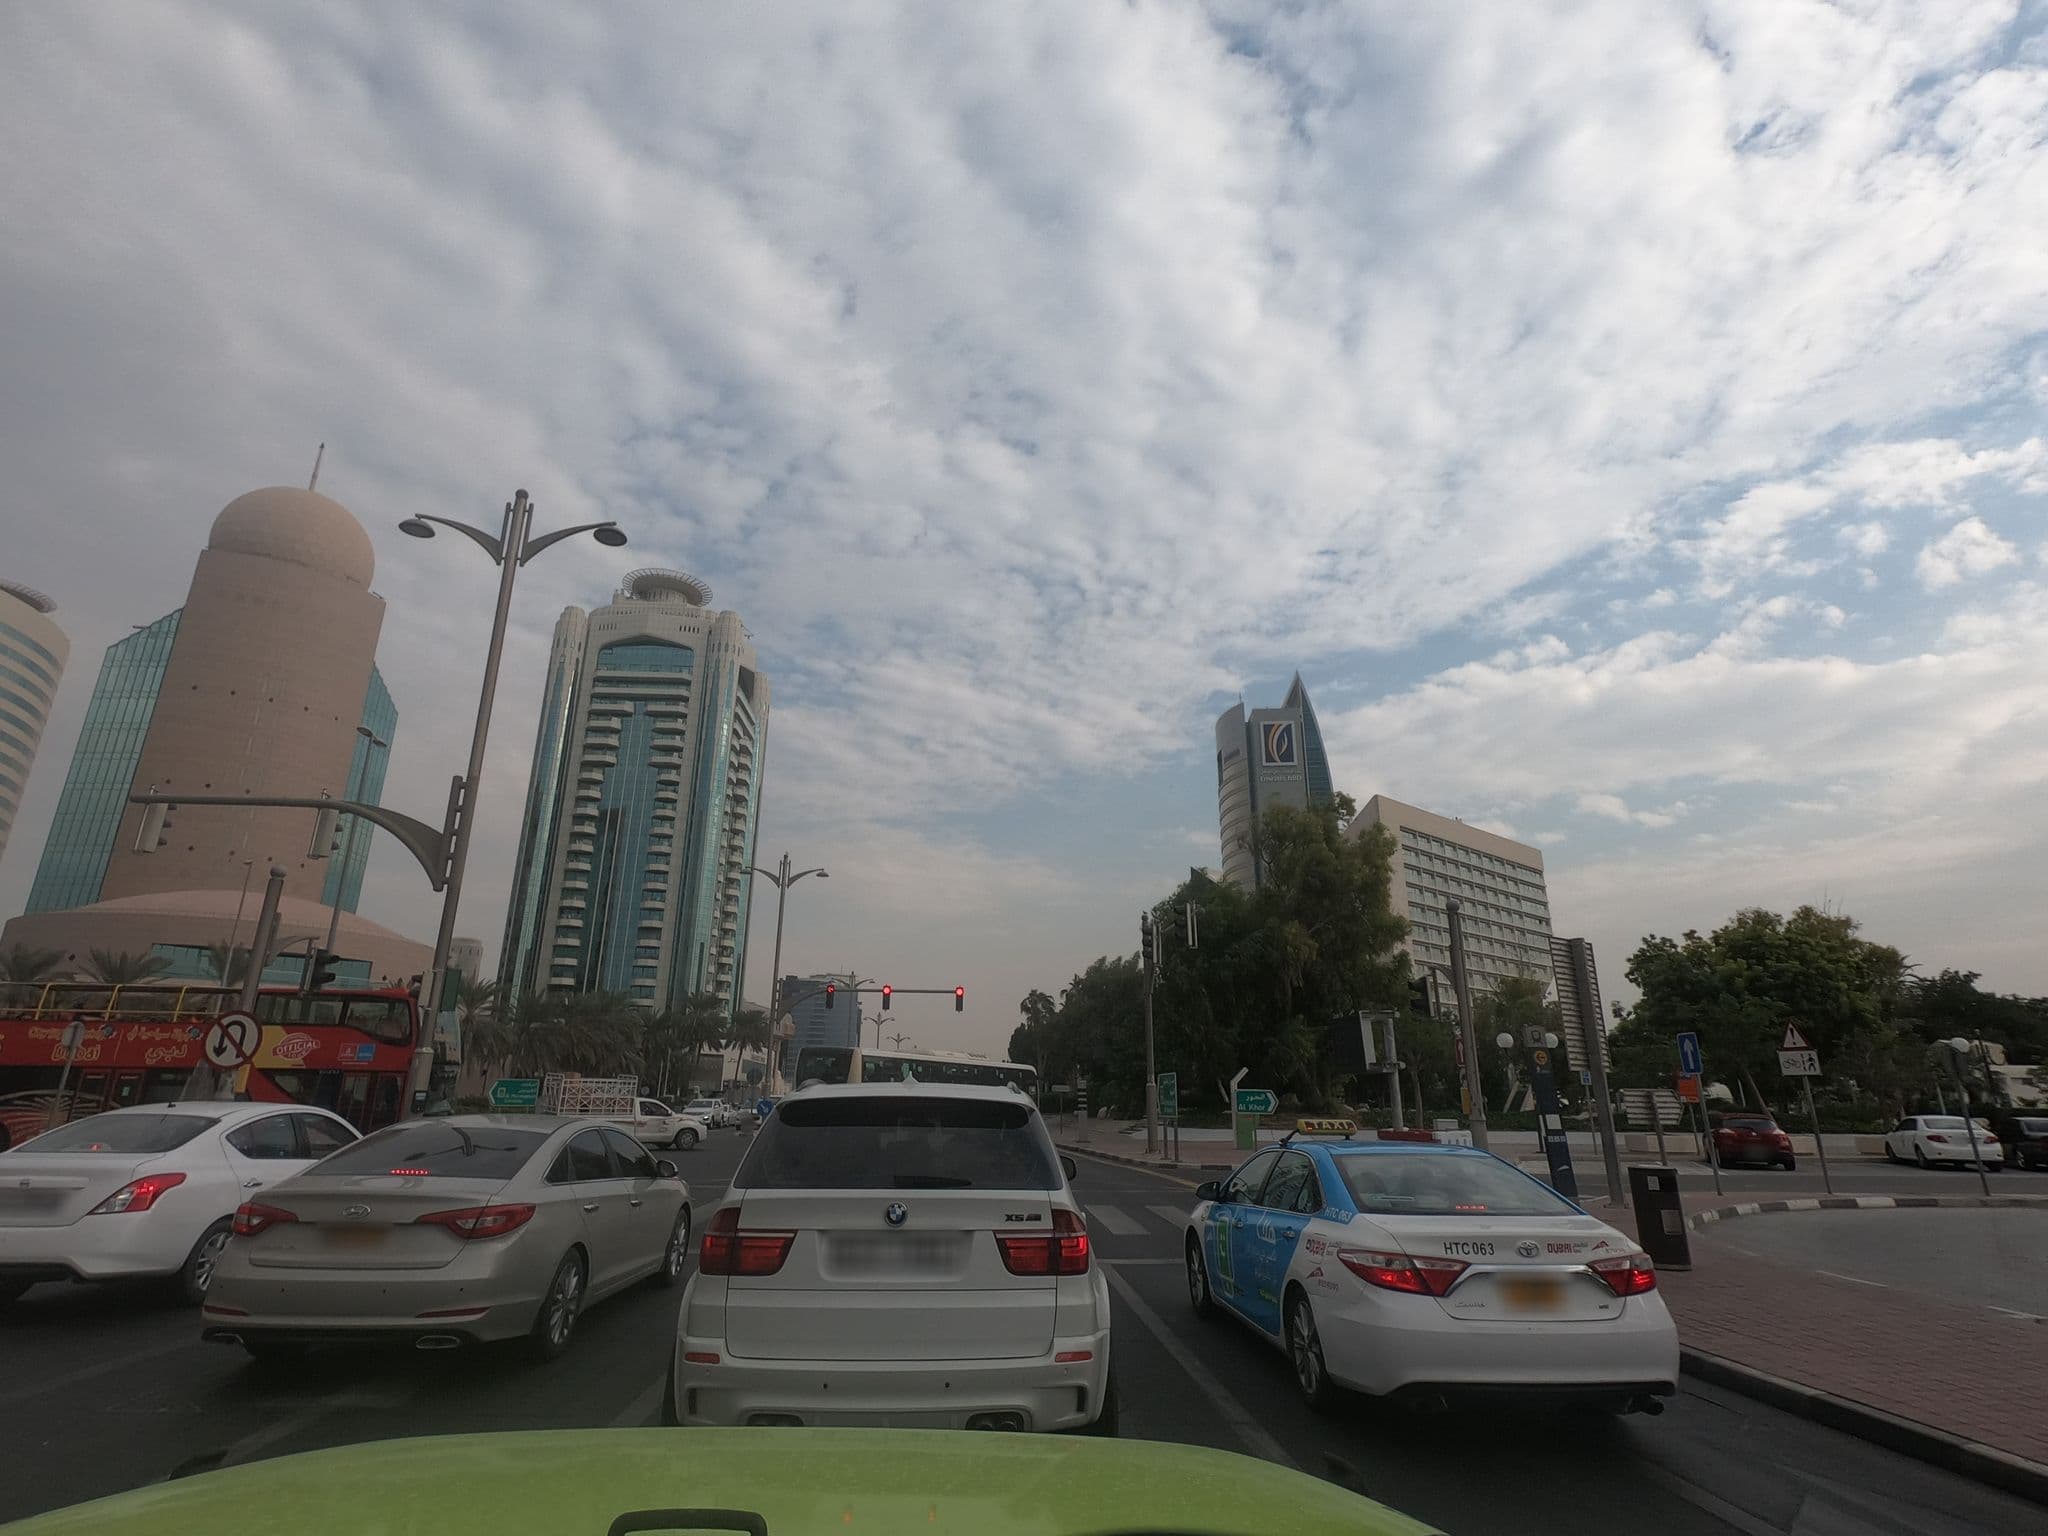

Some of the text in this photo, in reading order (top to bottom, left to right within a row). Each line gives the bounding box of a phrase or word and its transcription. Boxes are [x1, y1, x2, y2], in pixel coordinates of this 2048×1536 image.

[275, 1039, 318, 1055] OFFICIAL
[1249, 1103, 1266, 1111] Khor
[1312, 1121, 1350, 1129] TAXI
[1443, 1241, 1495, 1256] HTC 063
[1546, 1242, 1573, 1254] DUBAI
